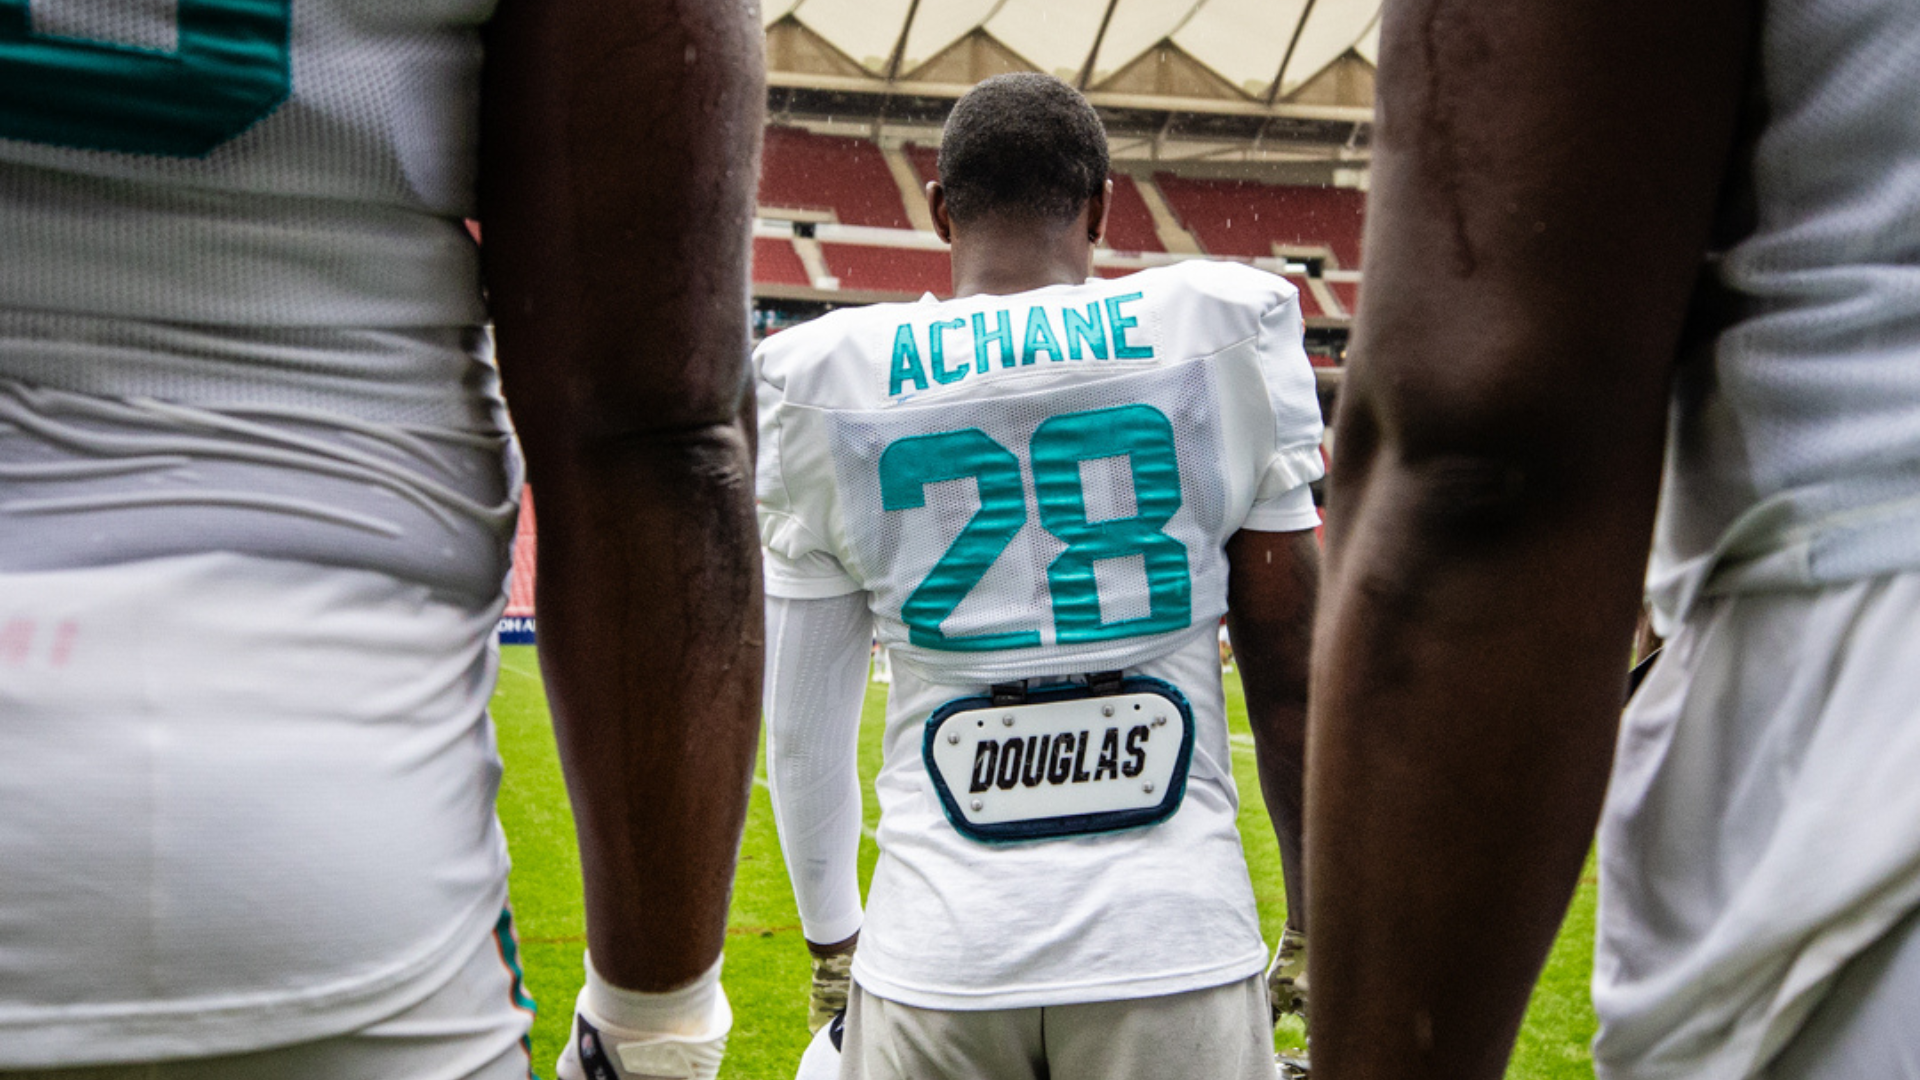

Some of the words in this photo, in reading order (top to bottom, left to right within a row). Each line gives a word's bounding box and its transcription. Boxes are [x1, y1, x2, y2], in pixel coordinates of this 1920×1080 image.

[889, 292, 1154, 396] ACHANE
[879, 404, 1191, 652] 28
[969, 725, 1150, 793] DOUGLAS
